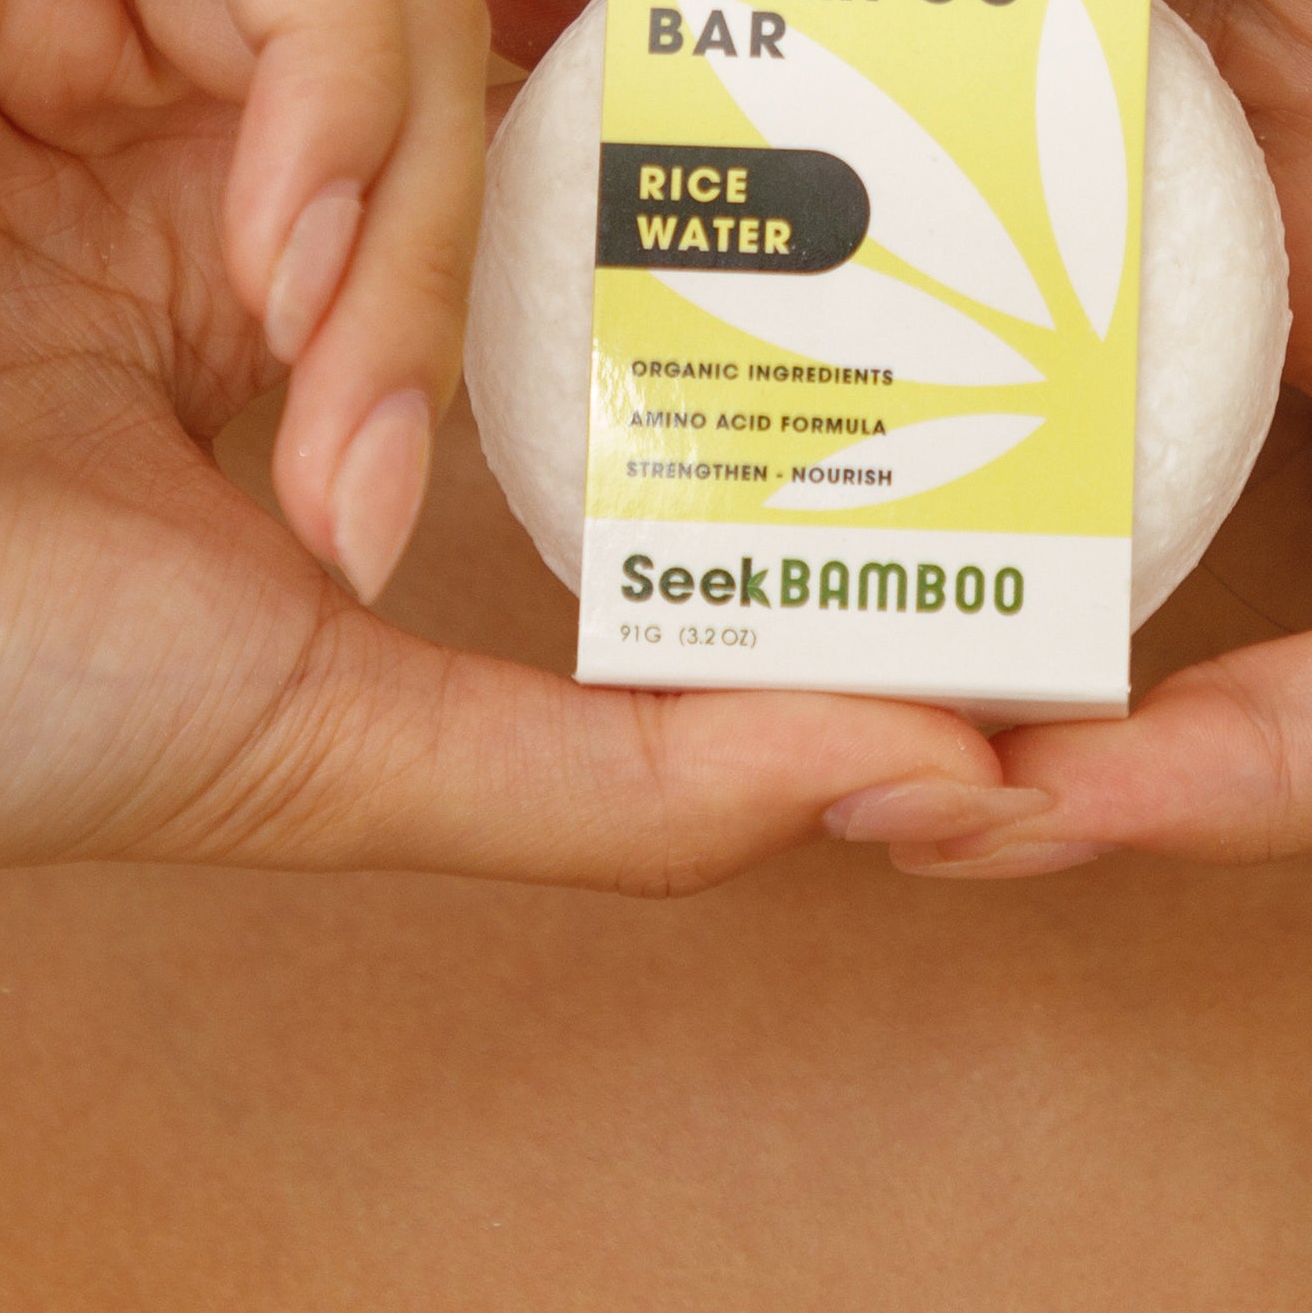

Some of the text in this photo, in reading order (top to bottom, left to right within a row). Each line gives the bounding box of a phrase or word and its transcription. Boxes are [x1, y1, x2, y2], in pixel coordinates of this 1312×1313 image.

[648, 8, 787, 58] BAR
[639, 167, 748, 203] RICE
[637, 217, 791, 254] WATER
[631, 361, 894, 385] ORGANIC INGREDIENTS
[629, 411, 886, 436] AMINO ACID FORMULA
[626, 462, 768, 481] STRENGTHEN
[792, 467, 892, 486] NOURISH
[620, 625, 757, 648] 91G (3.2 OZ)
